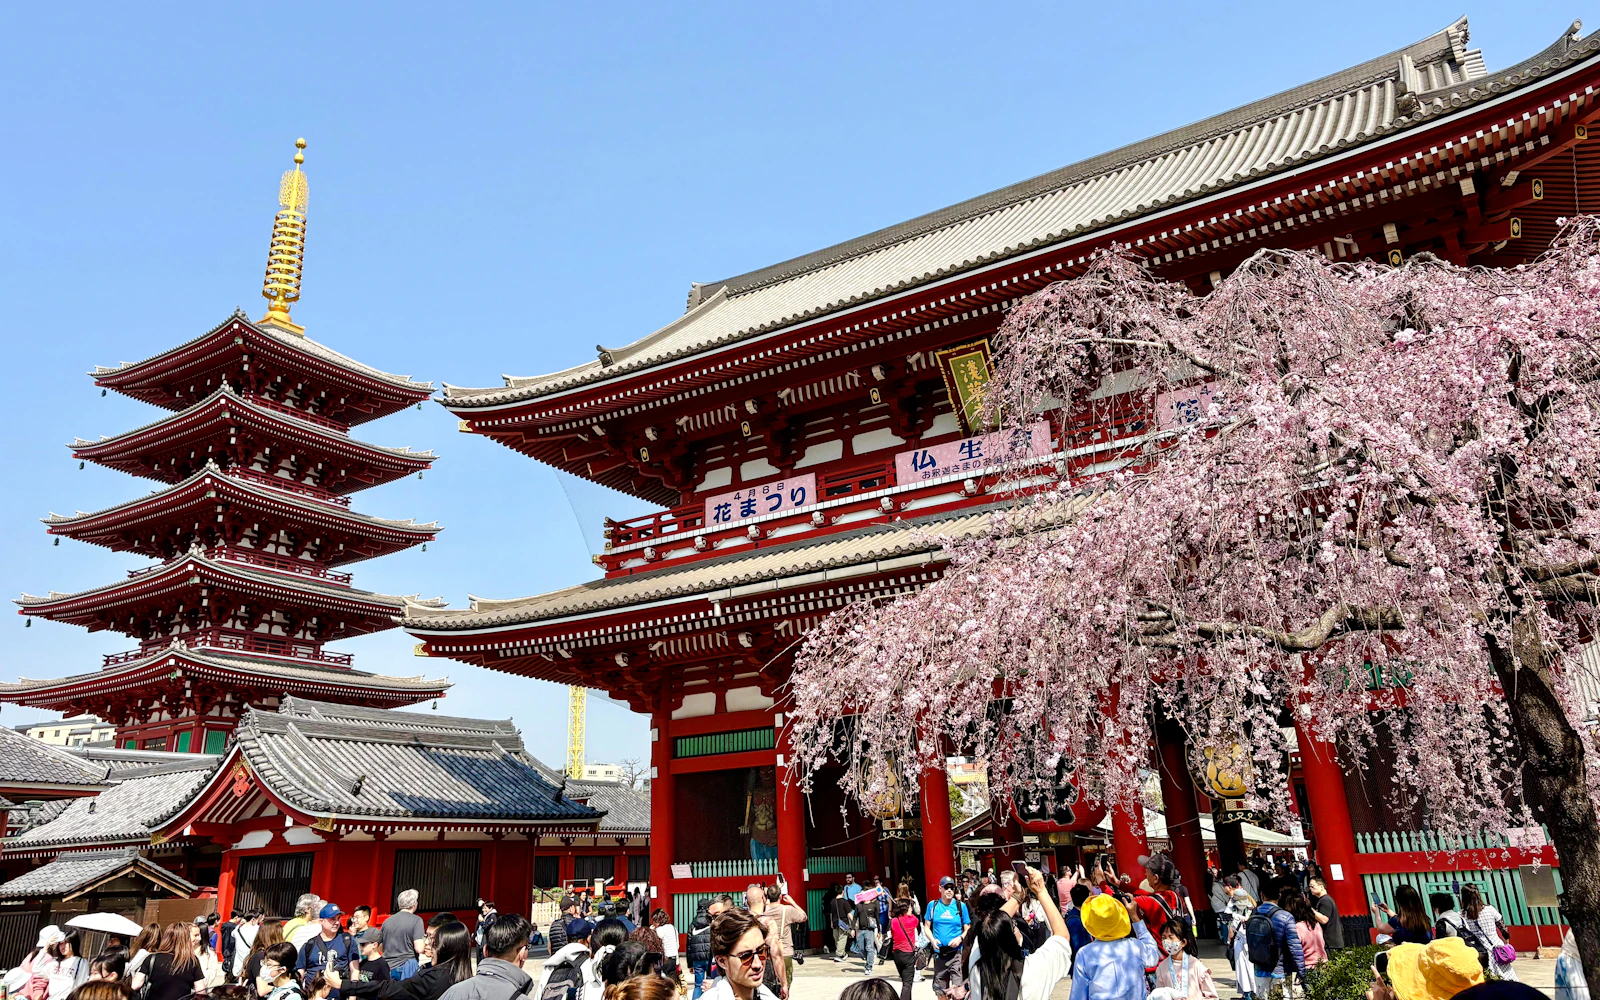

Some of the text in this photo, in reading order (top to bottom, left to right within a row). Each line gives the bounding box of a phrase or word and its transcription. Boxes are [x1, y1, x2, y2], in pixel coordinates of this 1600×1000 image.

[713, 486, 806, 524] 花まつり
[733, 482, 785, 501] 4月8日
